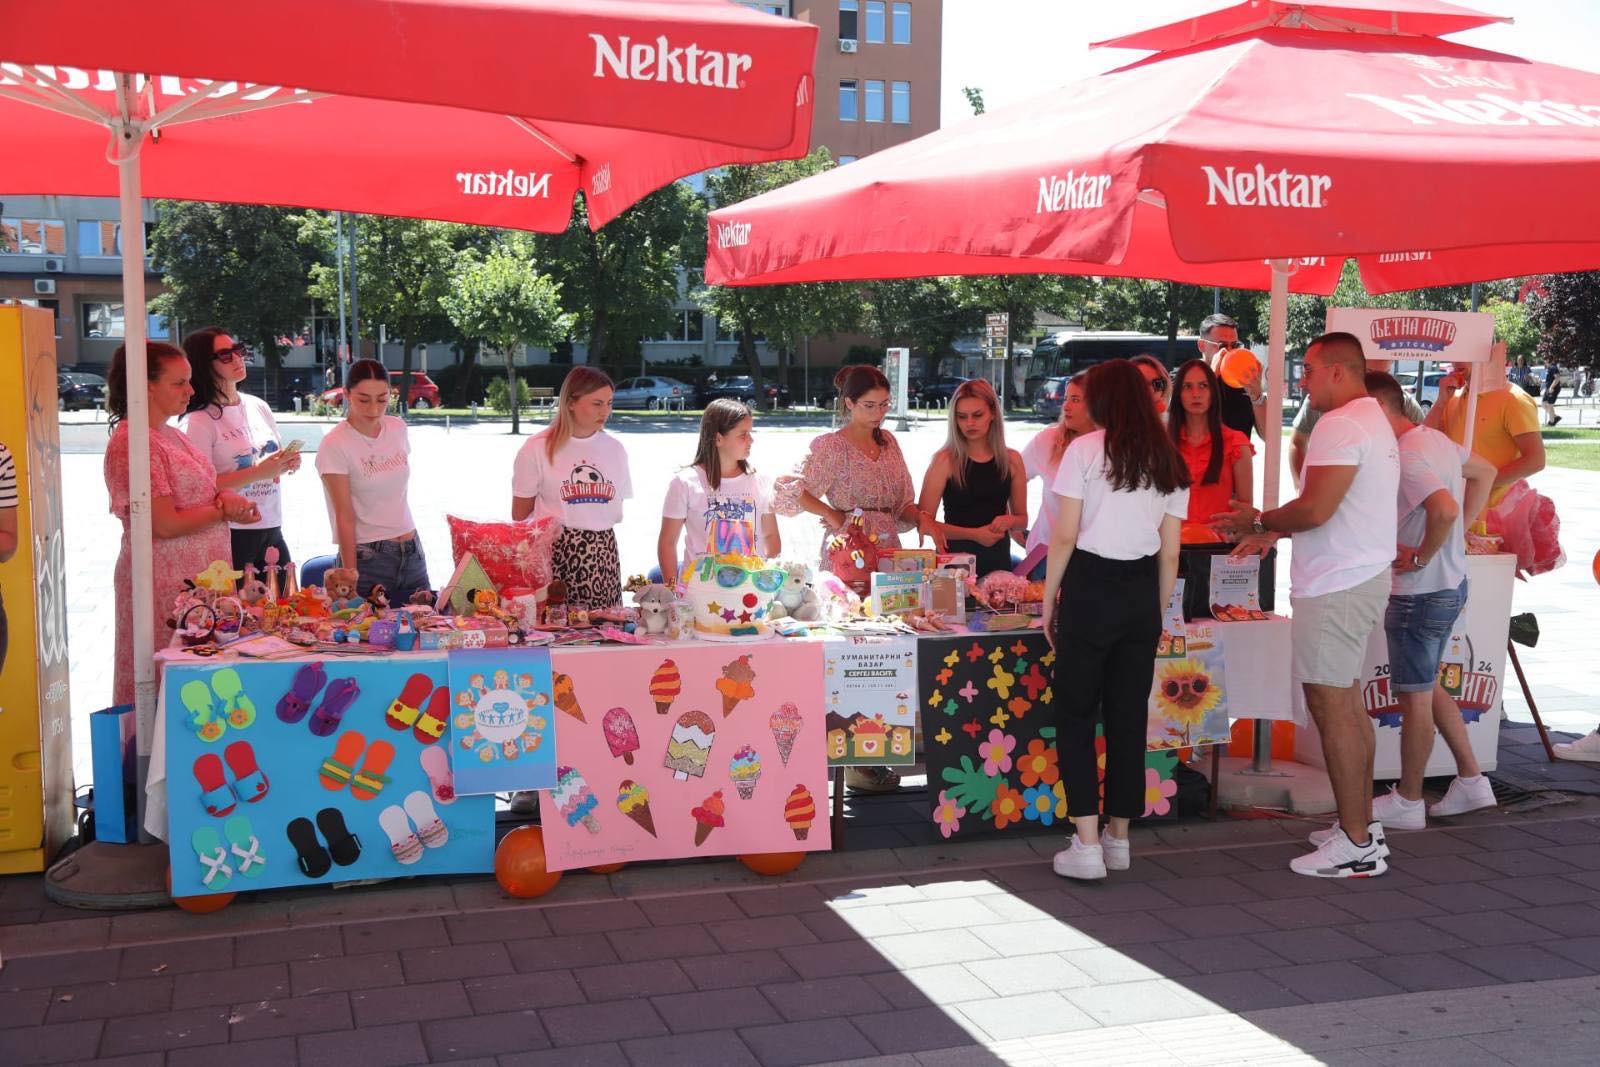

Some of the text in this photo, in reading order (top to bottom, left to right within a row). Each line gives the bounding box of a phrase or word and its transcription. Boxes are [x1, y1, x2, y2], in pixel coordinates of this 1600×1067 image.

[588, 33, 753, 89] Nektar
[1036, 169, 1112, 213] Nektar
[1200, 163, 1332, 208] Nektar
[716, 219, 752, 249] Nektar
[1422, 318, 1456, 341] ЛИГА
[1374, 661, 1493, 677] 20 24
[1455, 672, 1496, 705] ИГА
